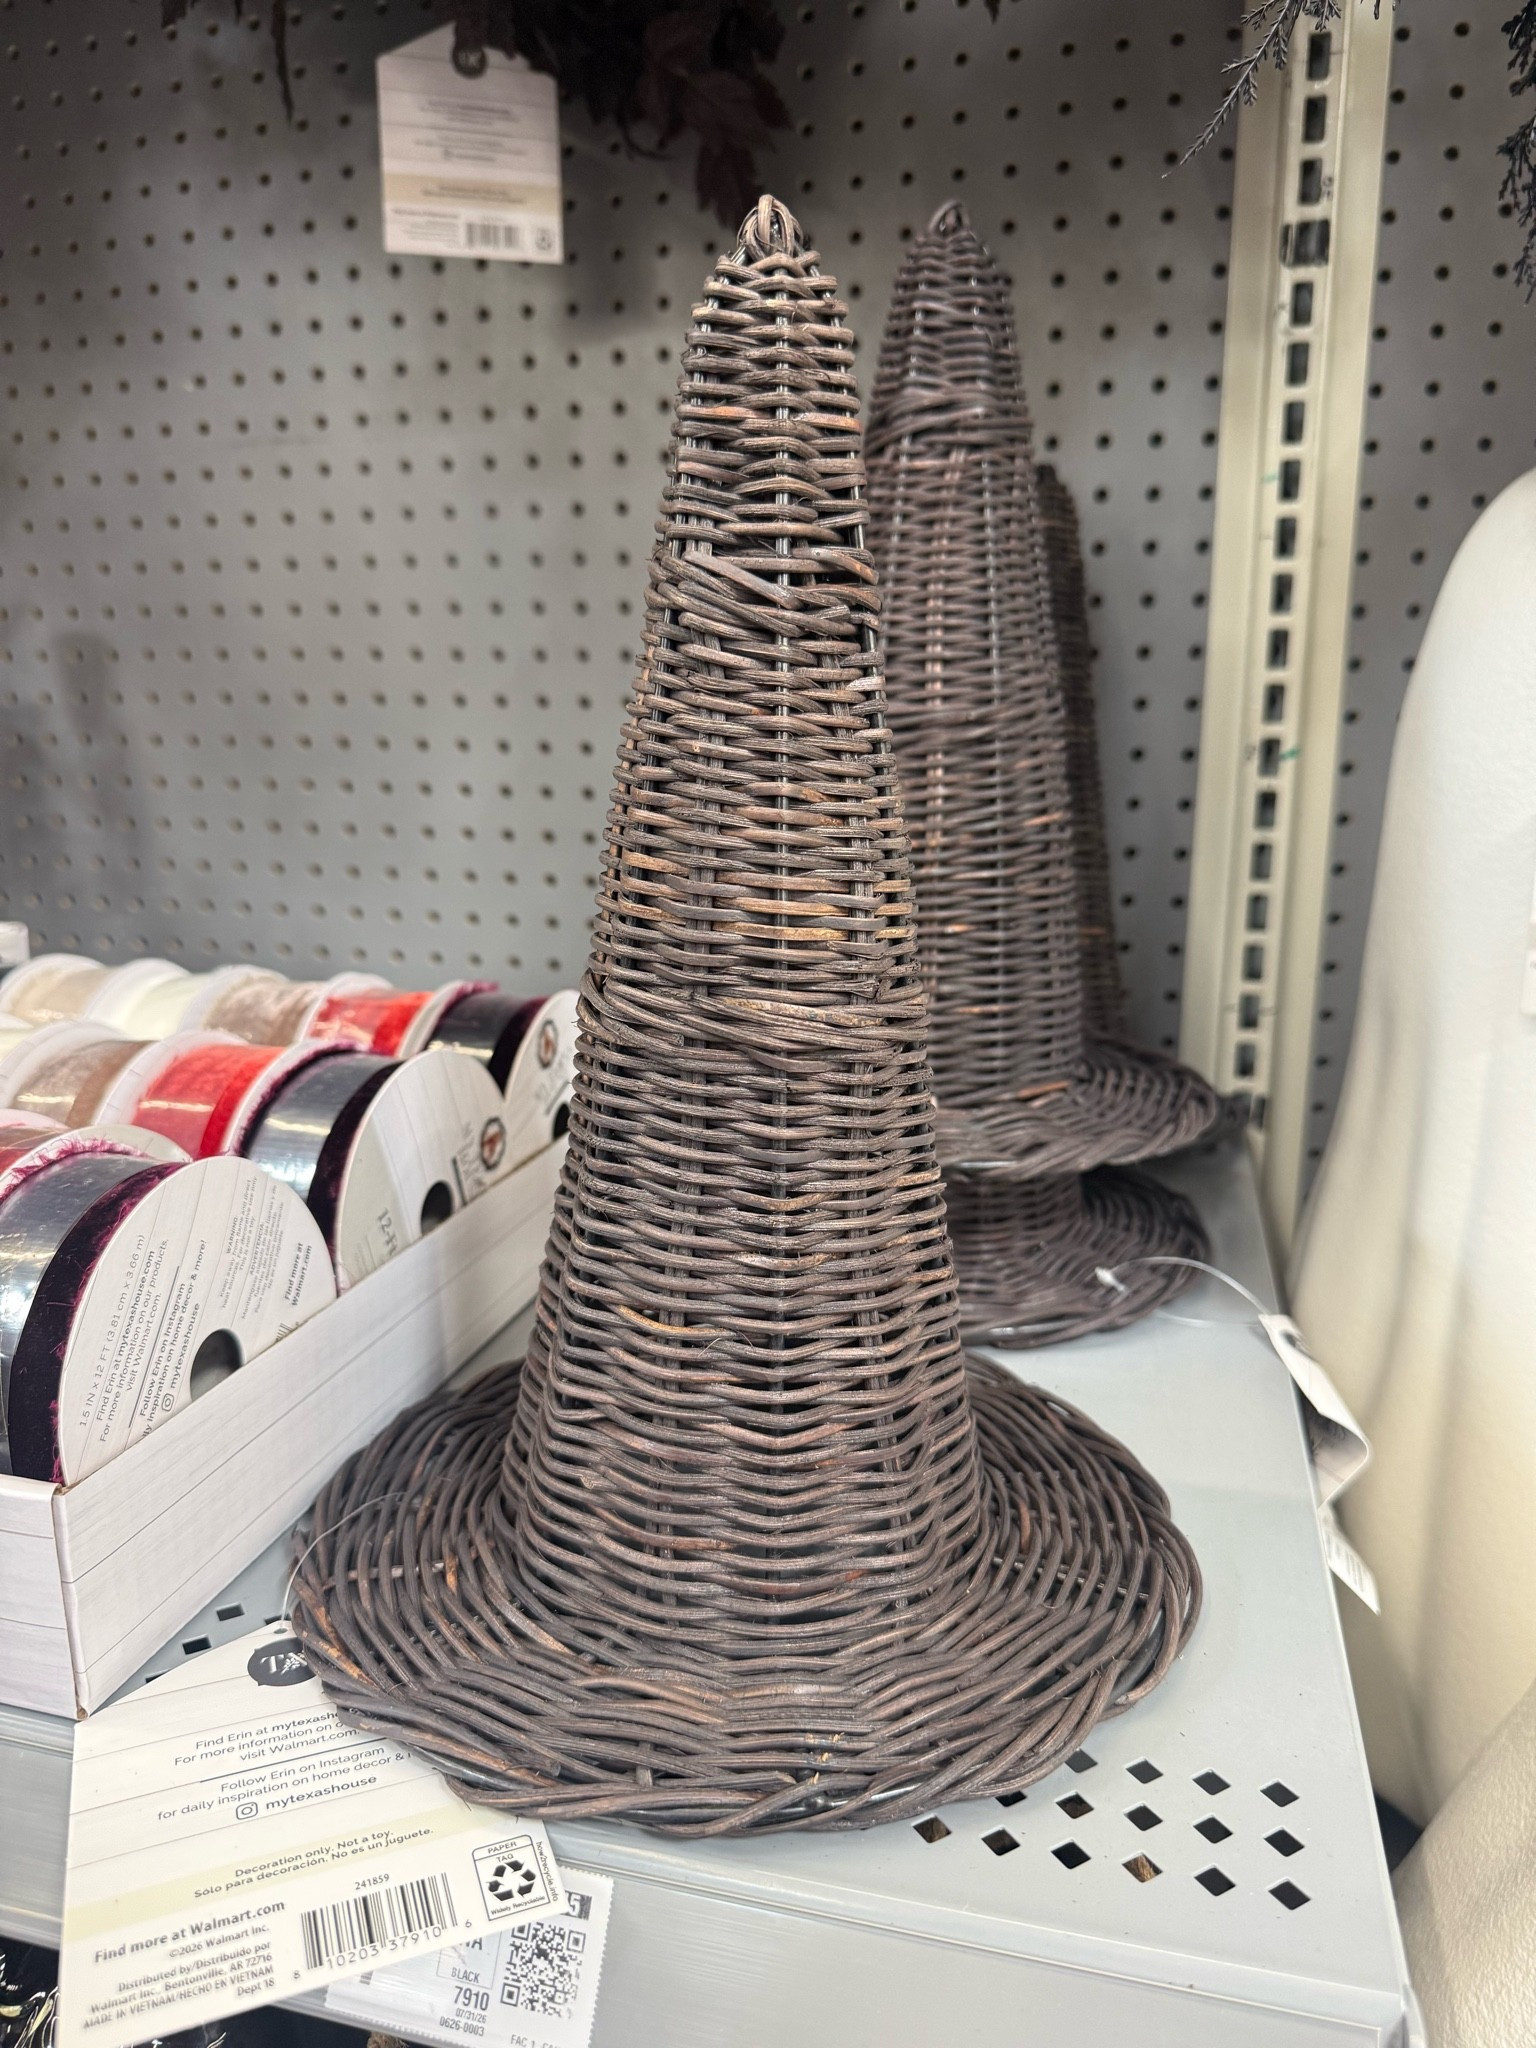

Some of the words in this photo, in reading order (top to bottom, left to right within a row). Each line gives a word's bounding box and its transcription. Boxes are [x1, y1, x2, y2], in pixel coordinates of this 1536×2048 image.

[136, 1234, 145, 1250] m)
[126, 1253, 139, 1278] 3.66
[284, 1279, 294, 1300] Find
[291, 1254, 300, 1278] more
[291, 1245, 312, 1306] Walmart.com
[124, 1282, 130, 1290] x
[118, 1292, 127, 1311] cm
[96, 1396, 110, 1421] Find
[105, 1372, 116, 1394] Erin
[114, 1360, 121, 1370] at
[118, 1250, 155, 1356] mytexashouse.com
[106, 1314, 120, 1342] (3.81
[147, 1364, 169, 1422] inspiration
[166, 1348, 174, 1363] on
[170, 1316, 184, 1346] home
[182, 1283, 194, 1314] decor
[195, 1240, 207, 1271] more!
[100, 1344, 110, 1361] FT
[140, 1378, 156, 1416] Follow
[152, 1356, 164, 1376] Erin
[160, 1340, 168, 1353] on
[164, 1283, 186, 1337] Instagram
[170, 1303, 200, 1389] mytexashouse
[95, 1364, 105, 1378] 12
[100, 1424, 110, 1442] For
[108, 1391, 121, 1420] more
[116, 1326, 140, 1389] information
[138, 1310, 146, 1324] on
[144, 1290, 152, 1308] our
[92, 1382, 100, 1390] x
[126, 1370, 138, 1392] visit
[86, 1392, 96, 1406] IN
[80, 1410, 90, 1426] 1.5
[174, 1754, 196, 1766] For
[200, 1746, 235, 1760] more
[238, 1729, 312, 1750] information
[316, 1724, 332, 1734] on
[196, 1737, 224, 1750] Find
[228, 1730, 252, 1742] Erin
[256, 1726, 268, 1736] at
[240, 1748, 270, 1761] visit
[269, 1730, 360, 1754] Walmart.com.
[220, 1775, 267, 1792] Follow
[270, 1768, 296, 1780] Erin
[300, 1764, 316, 1773] on
[320, 1746, 385, 1768] Instagram
[158, 1810, 178, 1820] for
[180, 1800, 215, 1814] daily
[218, 1782, 289, 1805] inspiration
[292, 1776, 310, 1786] on
[312, 1766, 350, 1782] home
[354, 1756, 392, 1771] decor
[395, 1752, 405, 1761] &
[265, 1776, 378, 1810] mytexashouse
[234, 1854, 302, 1878] Decoration
[305, 1846, 334, 1858] only.
[337, 1838, 359, 1850] Not
[372, 1830, 394, 1840] toy.
[487, 1840, 518, 1854] PAPER
[496, 1852, 514, 1863] TAG
[225, 1877, 254, 1891] para
[256, 1856, 328, 1880] decoración.
[331, 1850, 348, 1860] No
[351, 1846, 365, 1855] es
[368, 1842, 383, 1850] un
[536, 1840, 558, 1902] how2recycle.info
[354, 1873, 390, 1890] 241859
[94, 1944, 126, 1964] Find
[130, 1934, 168, 1954] more
[171, 1928, 186, 1942] at
[190, 1902, 286, 1936] Walmart.com
[168, 1940, 204, 1958] ©2026
[205, 1929, 249, 1949] Walmart
[251, 1924, 270, 1936] Inc.
[293, 1971, 301, 1980] 8
[326, 1944, 380, 1970] 10203
[388, 1925, 443, 1952] 37910
[464, 1919, 472, 1928] 6
[118, 1967, 177, 1993] Distributed
[180, 1946, 252, 1976] by/Distribuido
[254, 1942, 272, 1955] por
[451, 1966, 480, 1984] BLACK
[90, 1992, 136, 2014] Walmart
[164, 1968, 227, 1992] Bentonville,
[229, 1960, 244, 1973] AR
[244, 1952, 273, 1968] 72716
[237, 1982, 262, 1997] Dept
[264, 1977, 276, 1989] 18
[83, 2012, 114, 2030] MADE
[116, 2007, 127, 2020] IN
[129, 1984, 213, 2016] VIETNAM/HECHO
[214, 1980, 228, 1991] EN
[230, 1966, 275, 1985] VIETNAM
[454, 1986, 490, 2012] 7910
[439, 2016, 485, 2038] 0626-0003
[456, 2007, 487, 2024] 07/31/26
[510, 2034, 528, 2048] FAC
